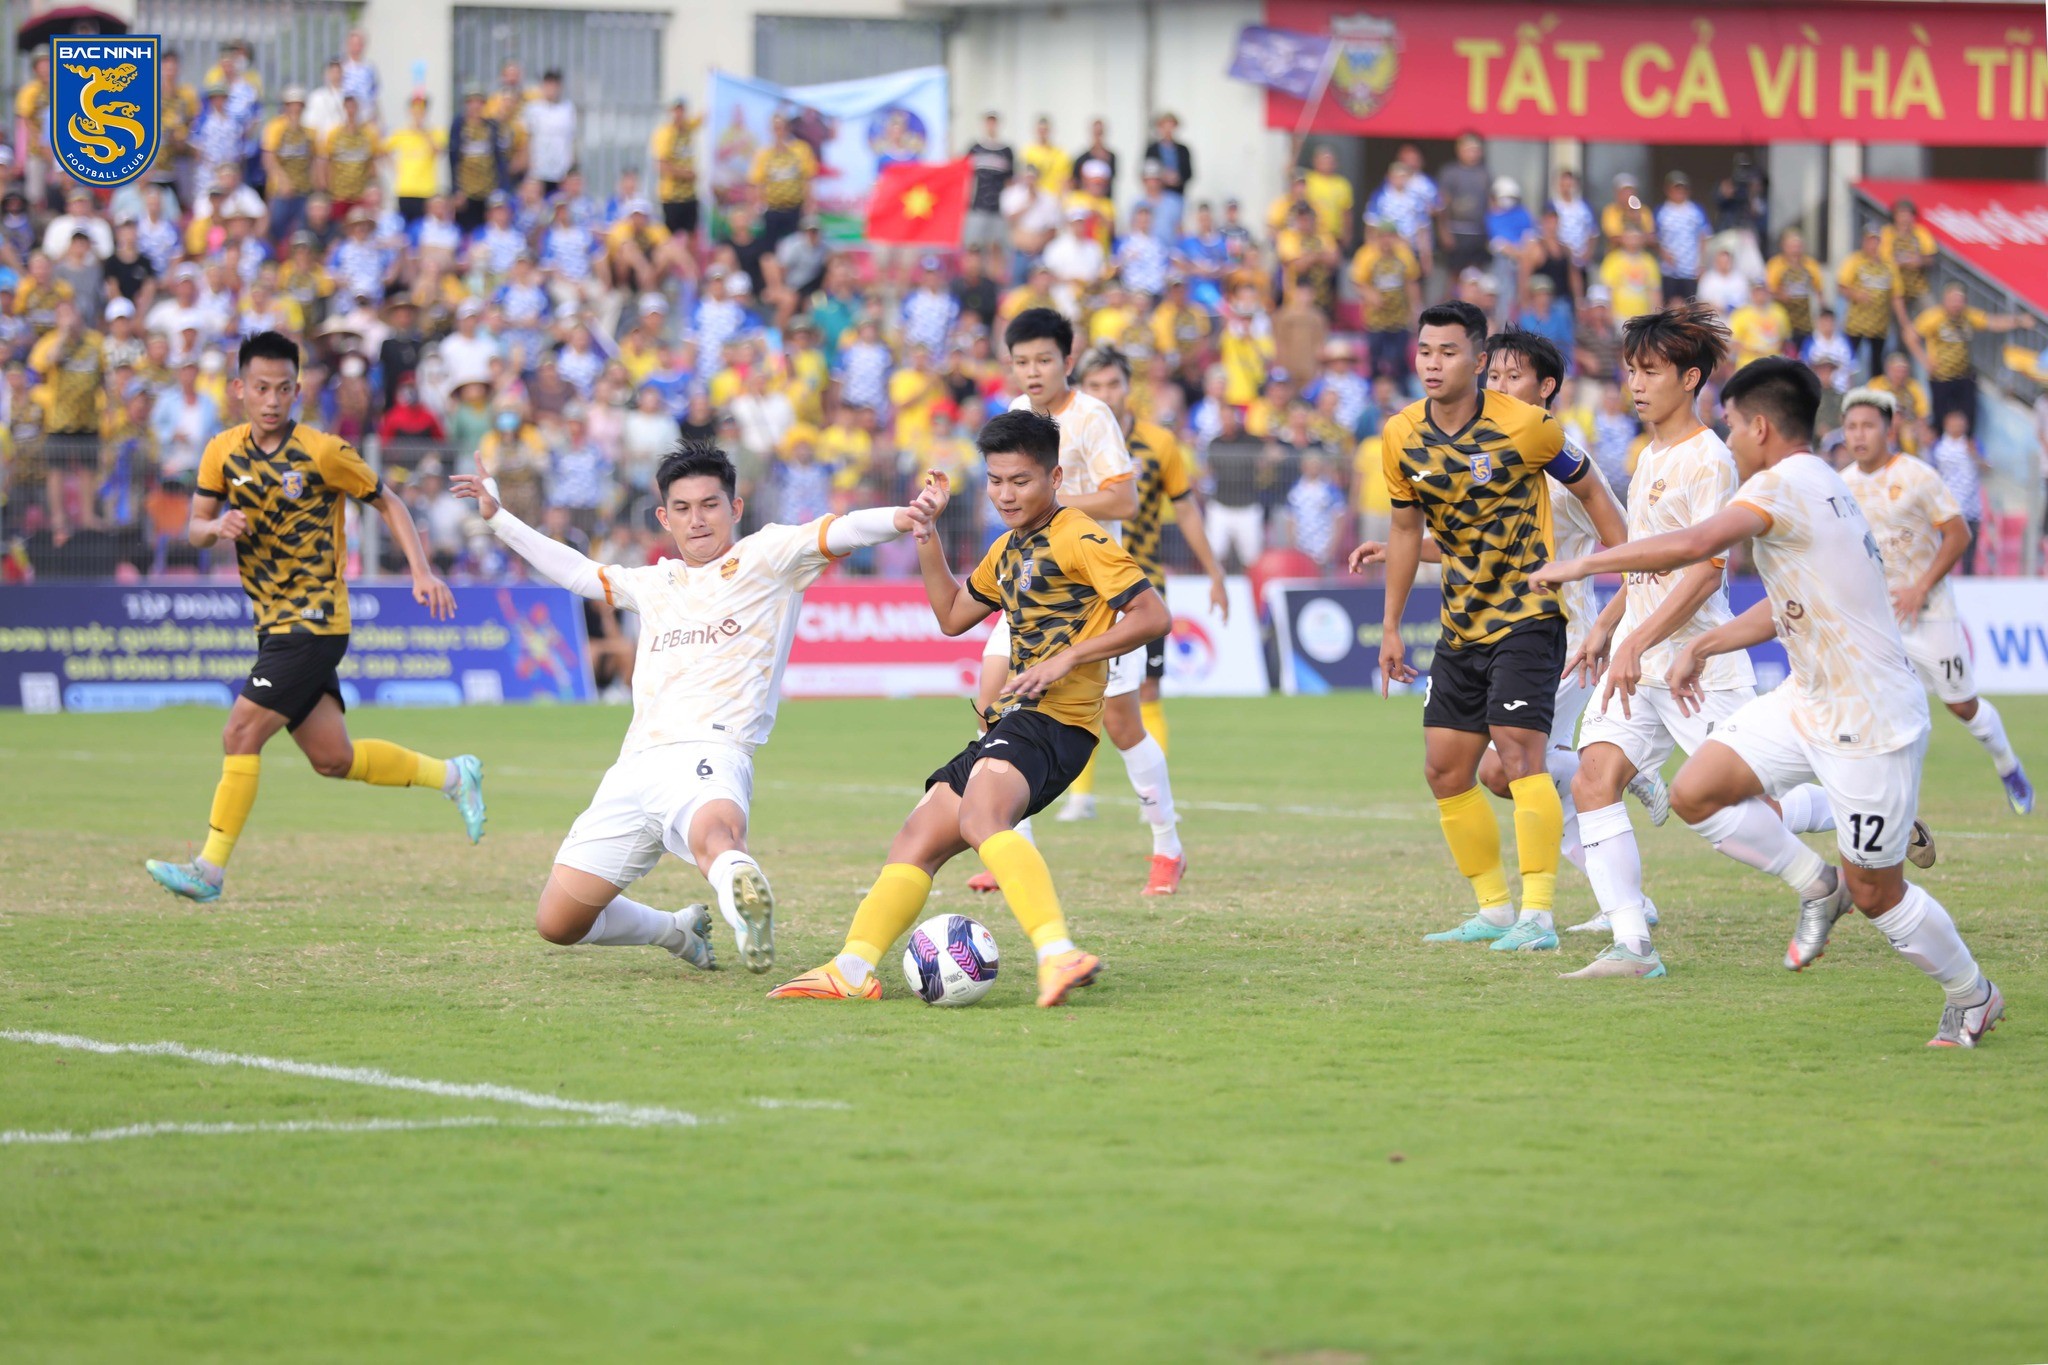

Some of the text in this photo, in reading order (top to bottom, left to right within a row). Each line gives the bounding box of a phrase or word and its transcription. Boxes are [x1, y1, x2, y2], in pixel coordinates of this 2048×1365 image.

[1455, 15, 1601, 115] TẤT
[1621, 18, 1731, 119] CẢ
[1747, 24, 1819, 118] VÌ
[1840, 23, 1946, 120] HÀ
[650, 625, 719, 652] LPBank
[1939, 655, 1963, 680] 79
[696, 758, 714, 777] 6
[1849, 813, 1884, 852] 12
